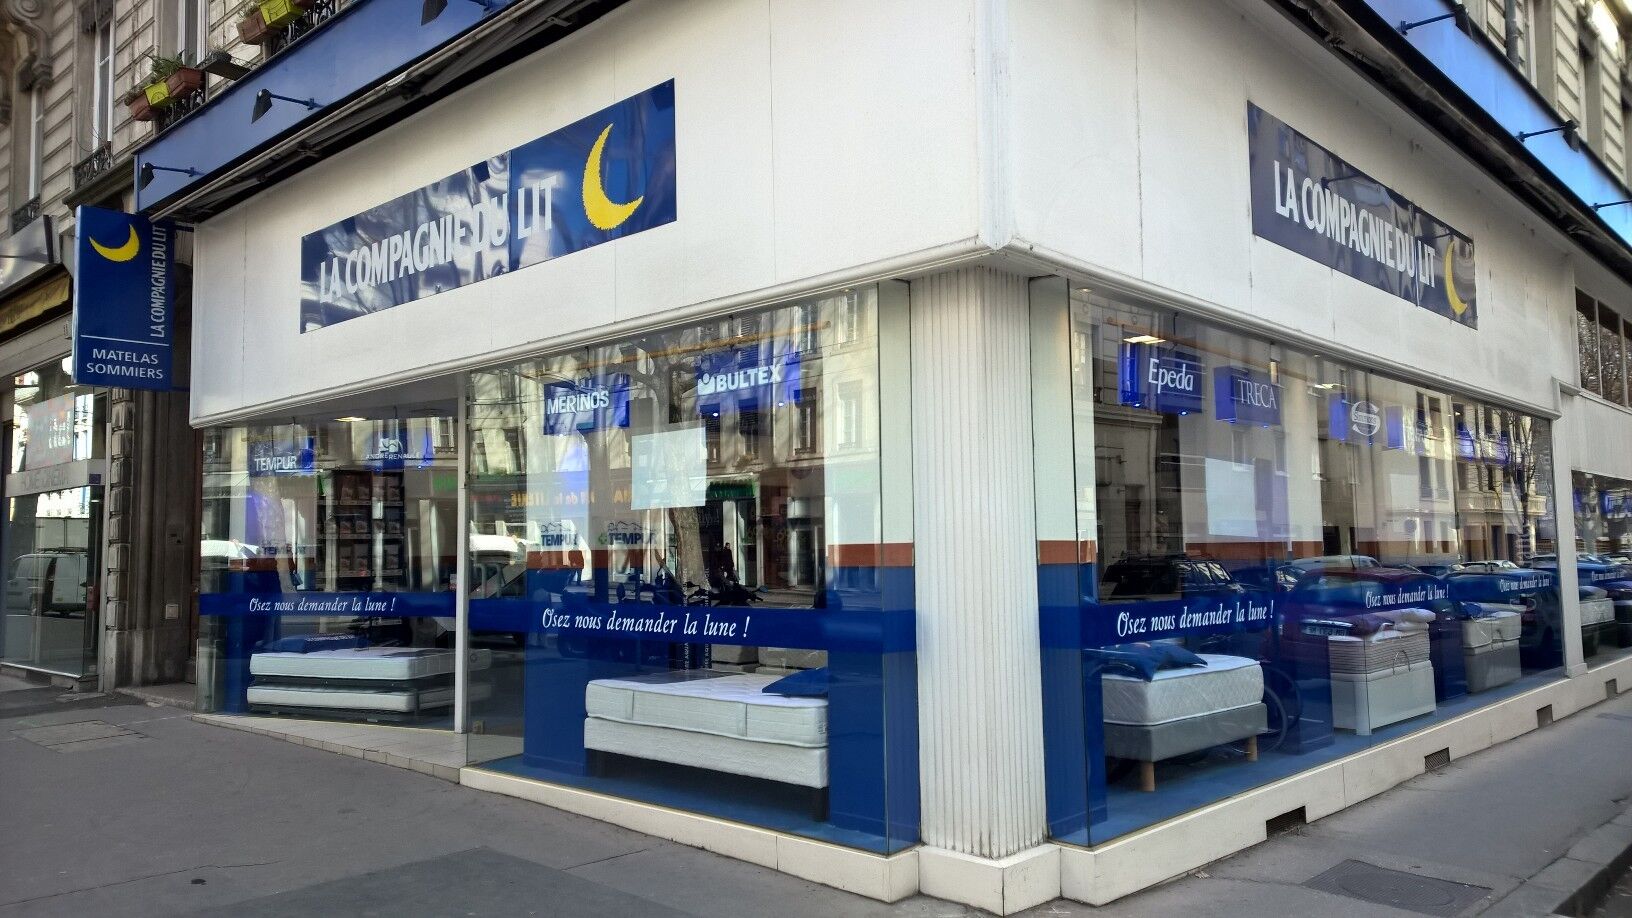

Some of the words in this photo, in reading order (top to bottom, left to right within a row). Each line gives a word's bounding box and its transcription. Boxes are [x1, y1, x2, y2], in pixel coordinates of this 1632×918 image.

[152, 225, 167, 241] LIT
[1274, 160, 1299, 223] LA
[1302, 177, 1394, 267] COMPAGNIE
[1396, 228, 1415, 277] DU
[1418, 240, 1436, 288] LIT
[152, 241, 166, 259] DU
[320, 256, 341, 303] LA
[345, 214, 467, 294] COMPAGNIE
[473, 193, 508, 253] DU
[517, 175, 557, 240] LIT
[151, 259, 165, 325] COMPAGNIE
[150, 324, 165, 338] LA
[92, 348, 159, 365] MATELAS
[86, 363, 164, 379] SOMMIERS
[716, 365, 782, 393] BULTEX
[1149, 358, 1194, 394] Epeda
[547, 390, 609, 414] MERINOS
[1238, 379, 1277, 409] TRECA
[254, 455, 297, 471] TEMPUR
[250, 598, 271, 612] Osez
[274, 601, 294, 611] nous
[298, 597, 347, 612] demander
[352, 597, 361, 612] la
[365, 597, 387, 612] lune
[1366, 590, 1381, 608] Osez
[1383, 594, 1396, 606] nous
[1398, 585, 1426, 604] demander
[542, 607, 570, 629] Osez
[574, 614, 602, 630] nous
[606, 610, 677, 634] demander
[683, 613, 697, 635] la
[703, 613, 737, 637] lune
[1117, 611, 1147, 637] Osez
[1151, 614, 1175, 631] nous
[1179, 603, 1232, 629] demander
[1236, 602, 1245, 622] la
[1249, 600, 1267, 621] lune
